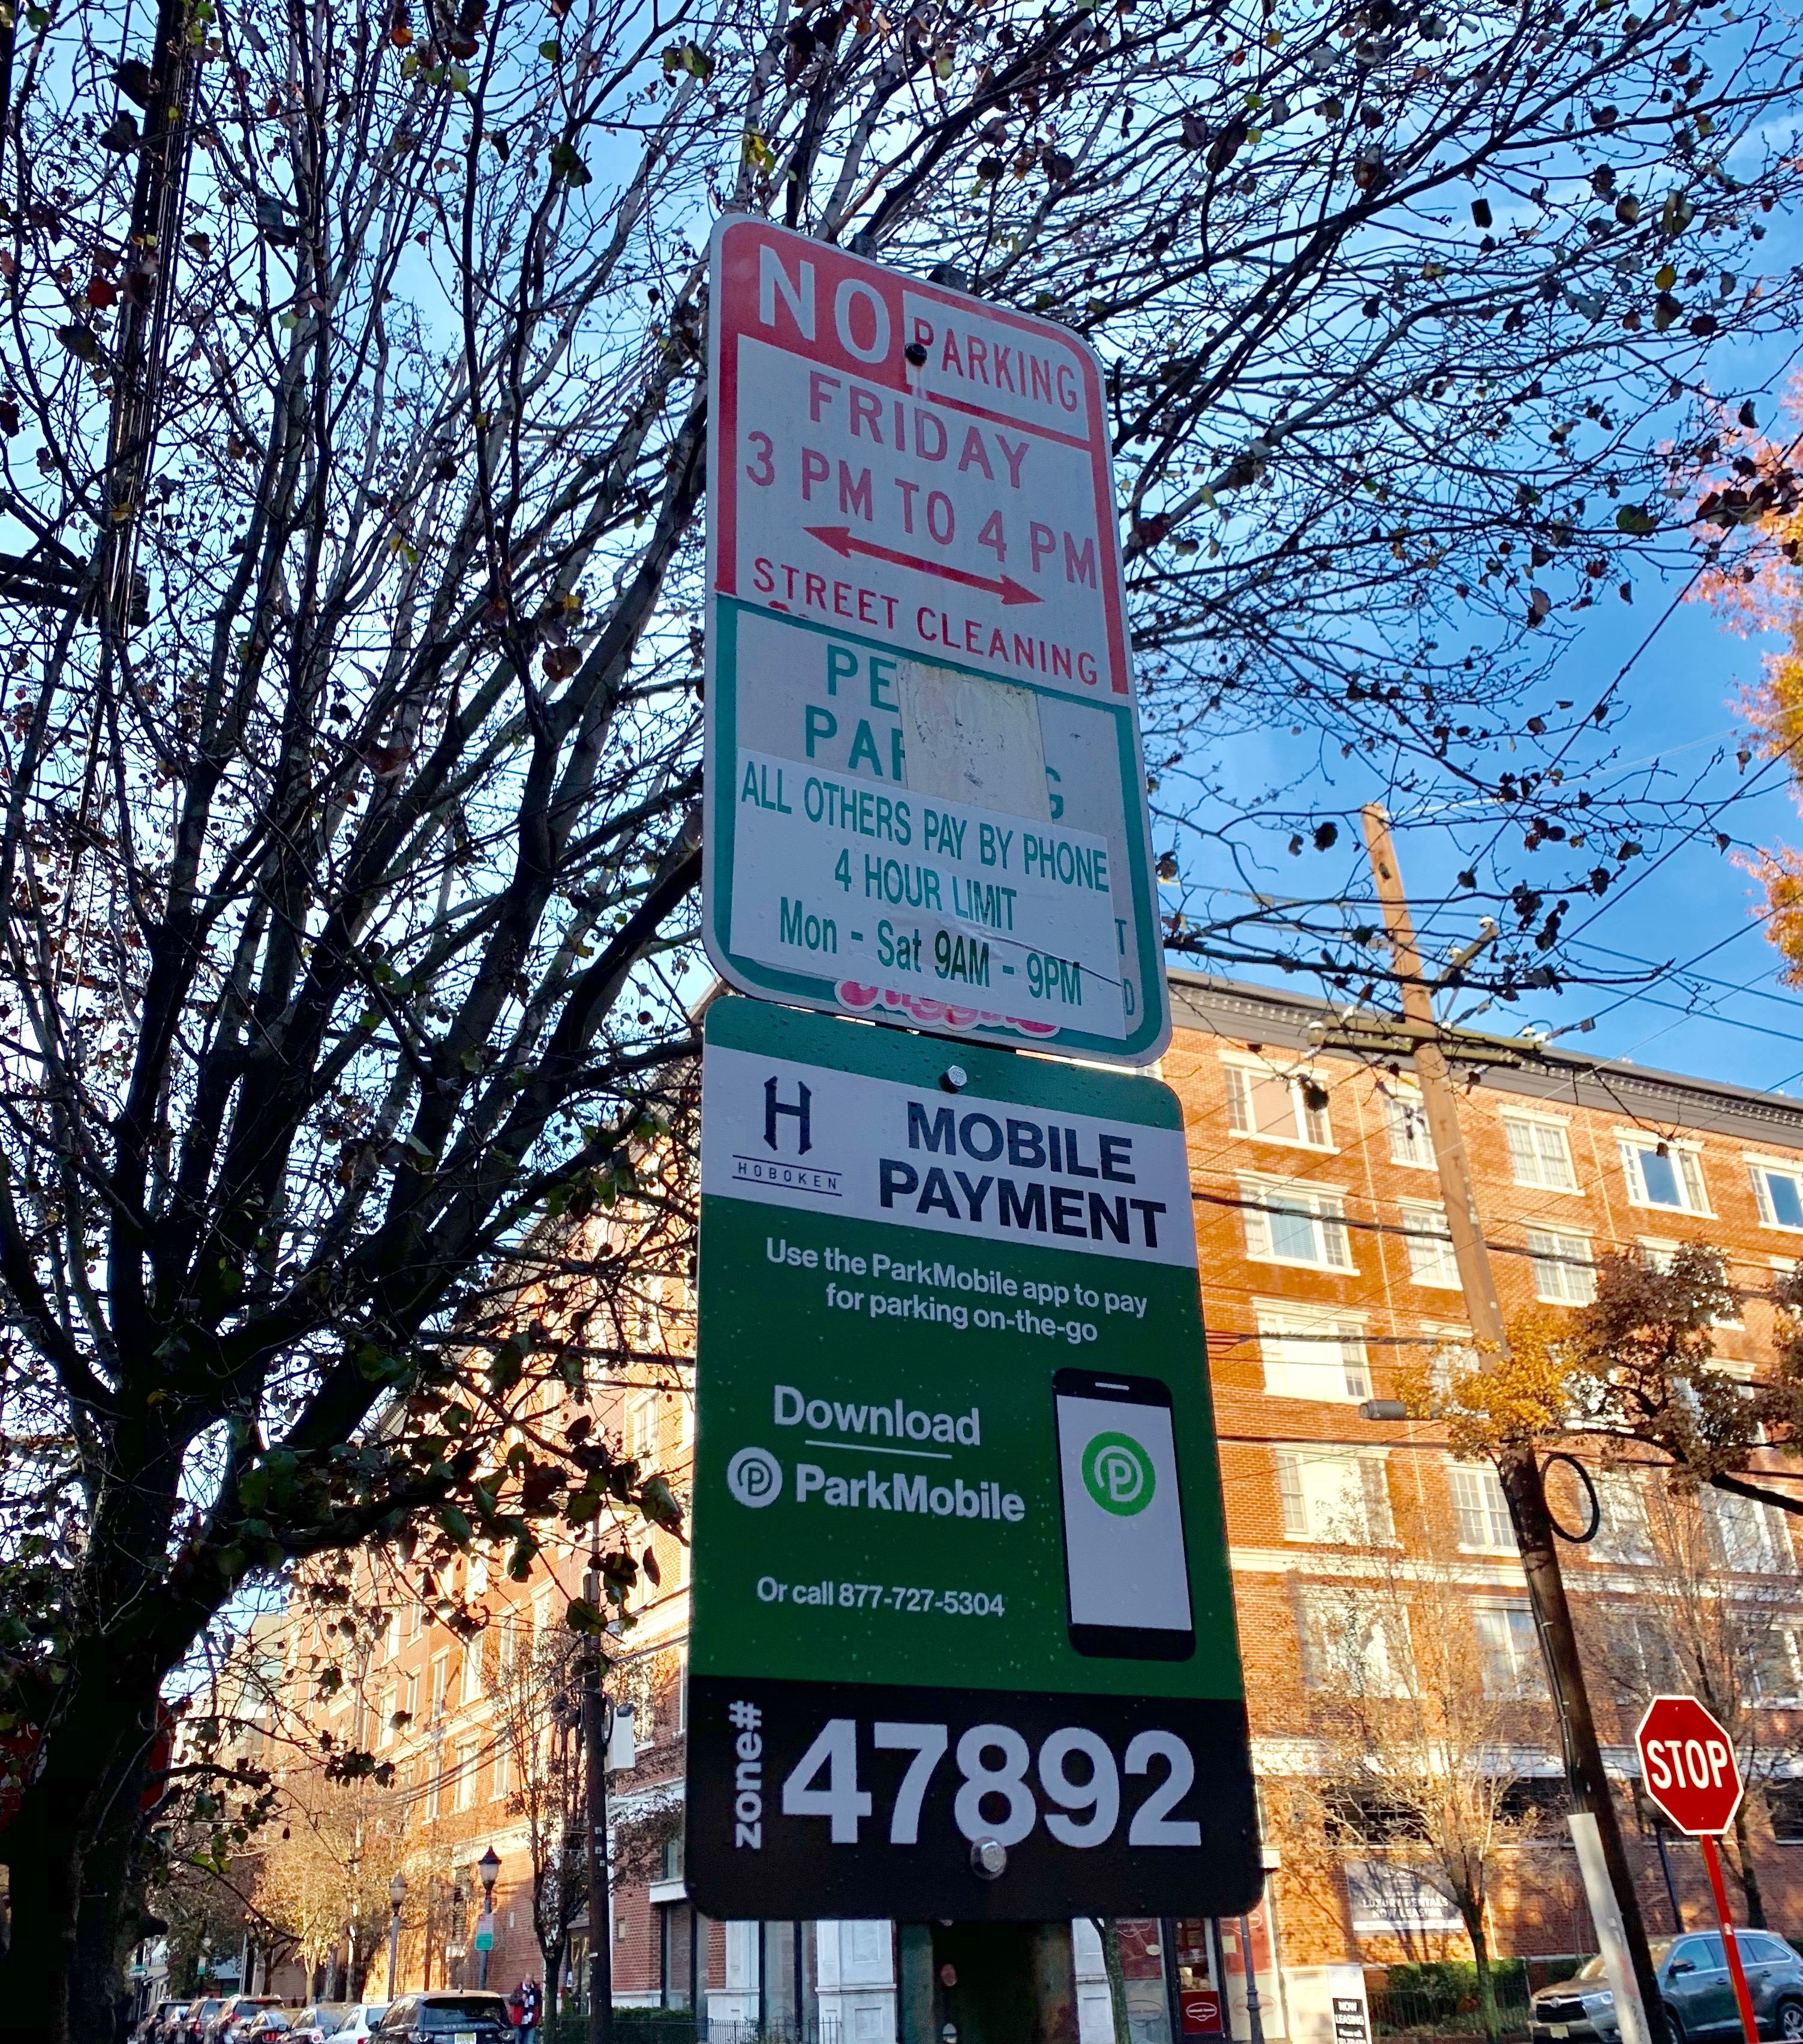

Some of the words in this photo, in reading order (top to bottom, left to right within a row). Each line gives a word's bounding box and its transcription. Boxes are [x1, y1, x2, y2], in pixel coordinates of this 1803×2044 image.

[760, 245, 890, 364] NO
[913, 317, 1077, 413] PARKING
[810, 371, 1029, 488] FRIDAY
[746, 431, 775, 487] 3
[802, 447, 873, 521] PM
[895, 478, 954, 545] TO
[978, 510, 1007, 562] 4
[1030, 521, 1096, 589] PM
[753, 557, 899, 629] STREET
[918, 607, 1097, 685] CLEANING
[741, 761, 792, 814] ALL
[804, 777, 910, 847] OTHERS
[924, 809, 967, 860] PAY
[979, 823, 1013, 870] BY
[1023, 835, 1108, 893] PHONE
[835, 848, 852, 892] 4
[865, 854, 942, 911] HOUR
[952, 875, 1017, 931] LIMIT
[781, 897, 836, 954] Mon
[877, 920, 922, 973] Sat
[934, 930, 990, 988] 9AM
[1026, 953, 1082, 1006] 9PM
[764, 1076, 812, 1155] H
[907, 1101, 1135, 1185] MOBILE
[738, 1161, 837, 1190] HOBOKEN
[879, 1158, 1167, 1248] PAYMENT
[766, 1237, 818, 1269] Use
[825, 1248, 866, 1277] the
[873, 1253, 1017, 1298] ParkMobile
[1023, 1282, 1069, 1307] app
[1075, 1284, 1099, 1308] to
[1105, 1292, 1147, 1319] pay
[827, 1283, 861, 1310] for
[870, 1291, 967, 1331] parking
[973, 1307, 1098, 1344] on-the-go
[774, 1385, 980, 1446] Download
[797, 1463, 1025, 1523] ParkMobile
[757, 1577, 787, 1603] Or
[792, 1582, 834, 1605] call
[839, 1584, 1005, 1617] 877-727-5304
[729, 1700, 761, 1849] zone#
[782, 1719, 1201, 1848] 47892
[1647, 1740, 1728, 1789] STOP
[1363, 1898, 1401, 1908] LUXURY
[1405, 1898, 1449, 1907] RENTALS
[1400, 1907, 1443, 1917] LEASING
[1335, 2014, 1365, 2025] LEASING
[1338, 2001, 1357, 2012] NOW
